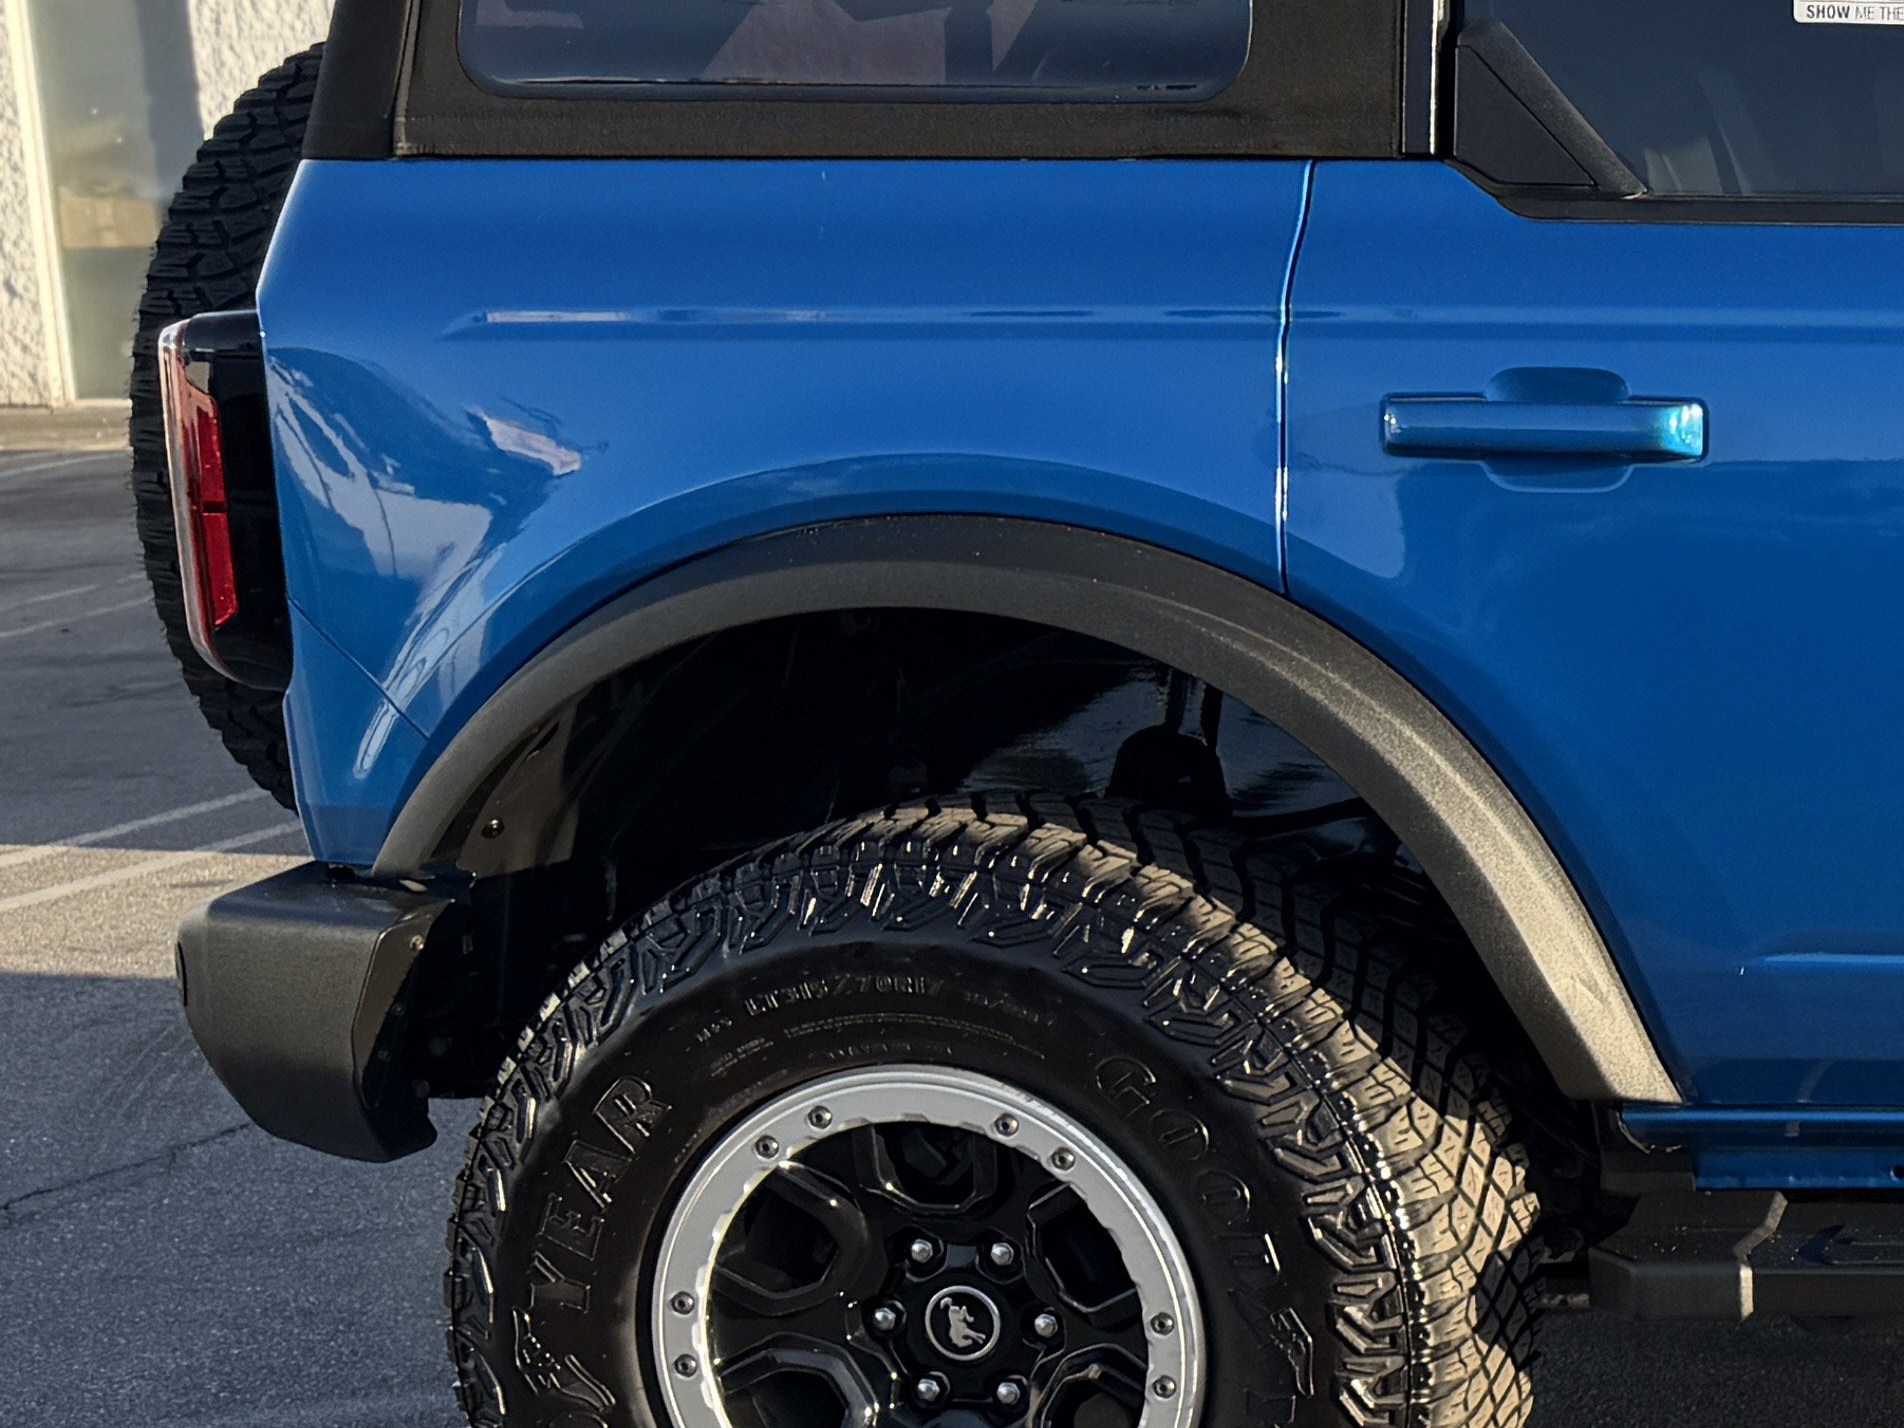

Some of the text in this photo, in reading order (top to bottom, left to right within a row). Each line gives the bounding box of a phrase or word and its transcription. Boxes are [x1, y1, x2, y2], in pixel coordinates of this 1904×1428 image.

[1806, 4, 1850, 19] SHOW
[1855, 6, 1875, 20] ME
[1879, 7, 1904, 21] THE
